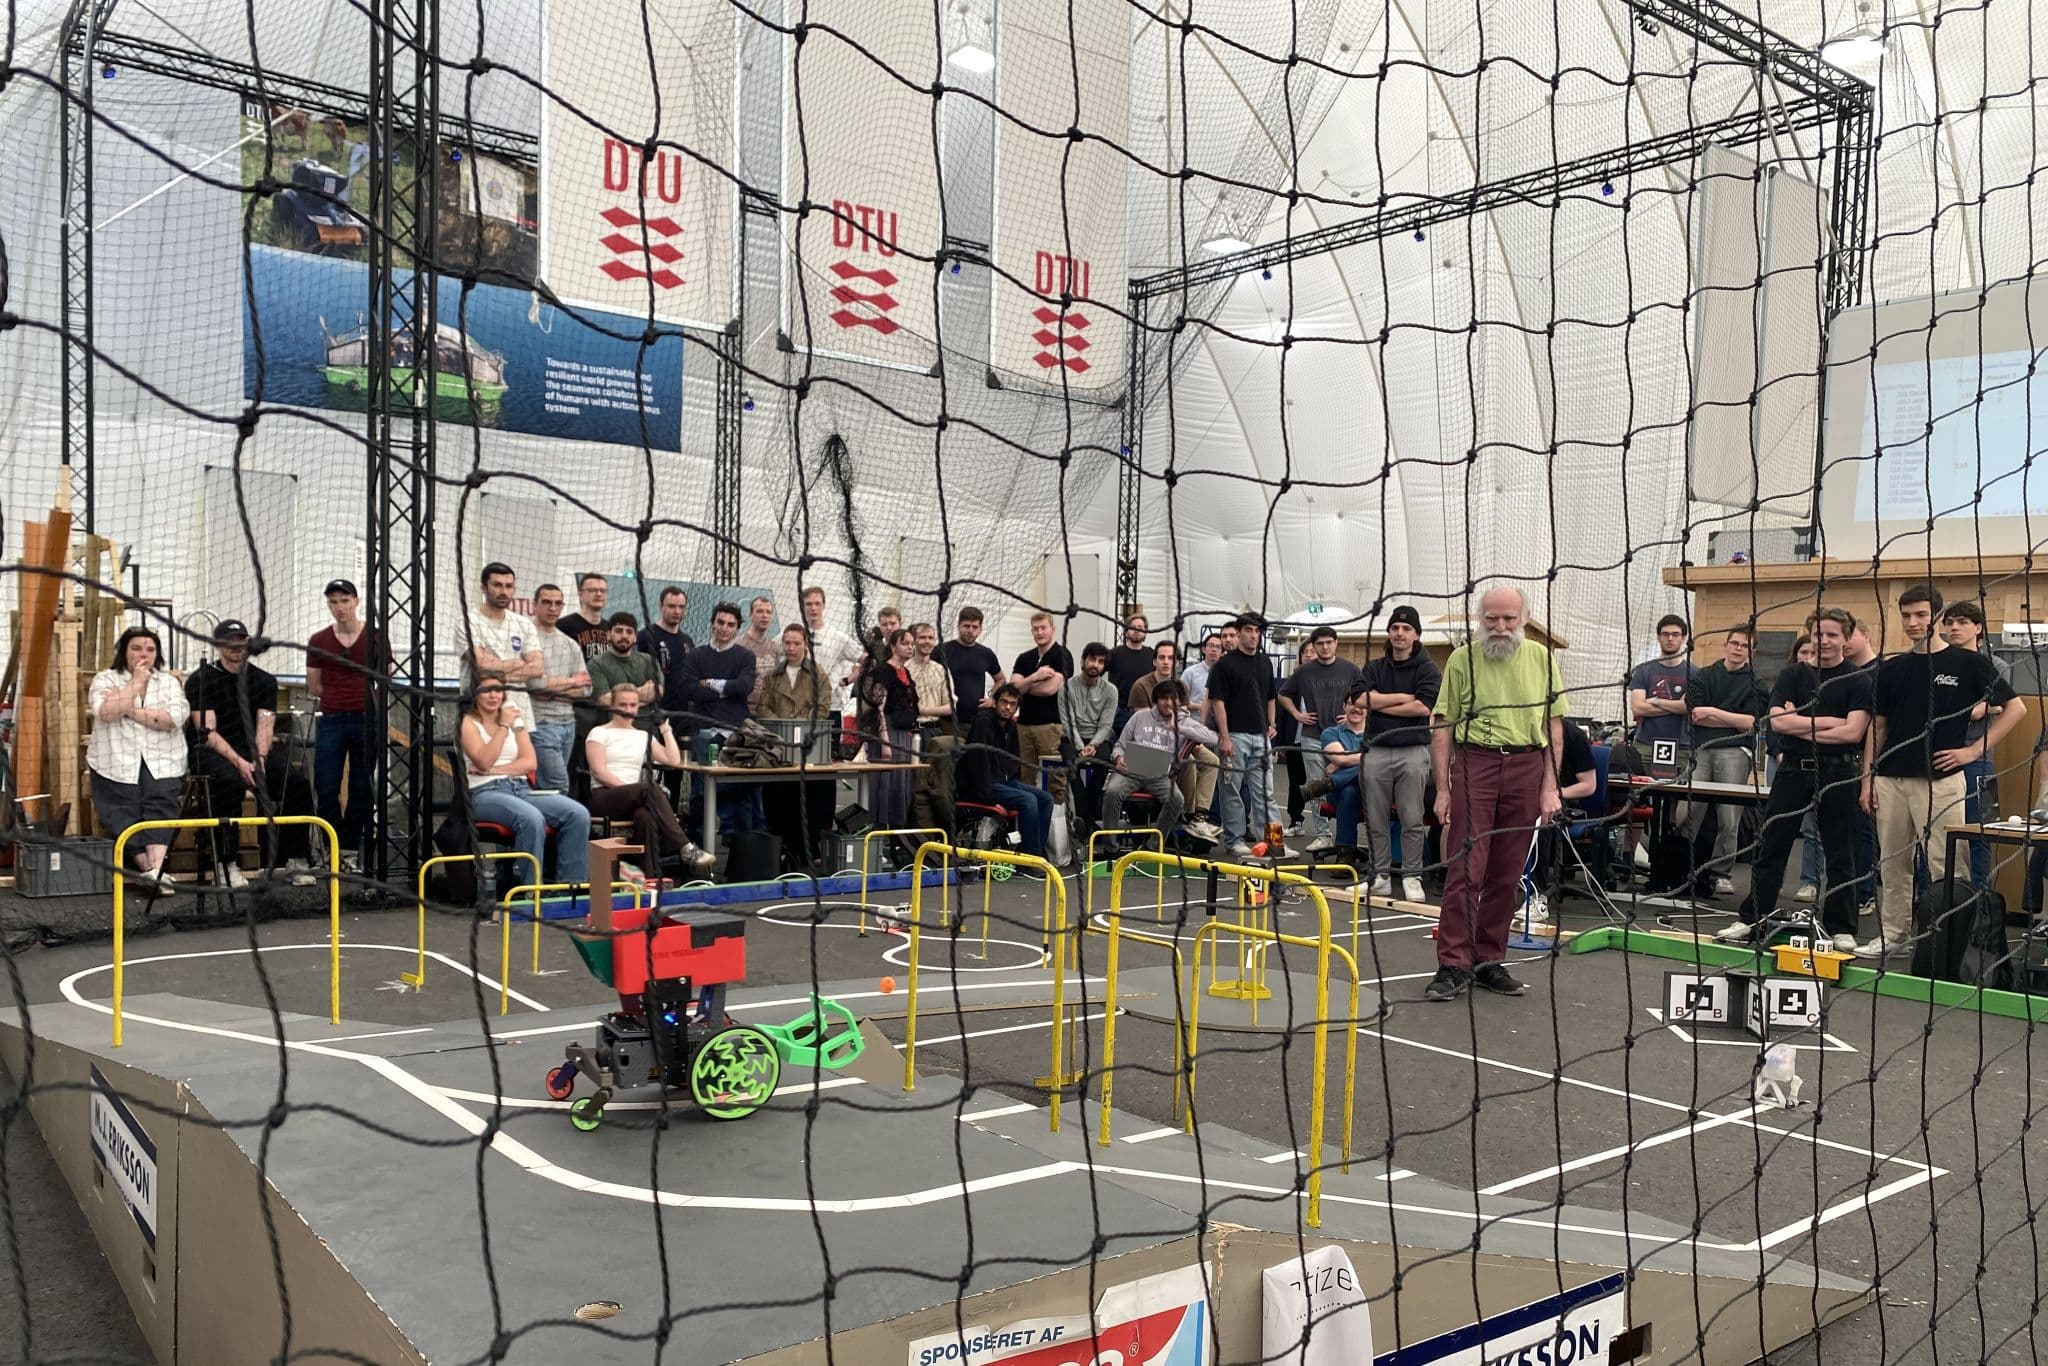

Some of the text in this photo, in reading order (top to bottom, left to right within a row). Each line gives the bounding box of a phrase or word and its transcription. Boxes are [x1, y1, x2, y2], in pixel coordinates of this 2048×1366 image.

[833, 199, 896, 257] DTU
[1036, 250, 1089, 301] DTU
[546, 357, 580, 370] Towards
[582, 364, 587, 372] a
[545, 380, 560, 389] the
[561, 383, 600, 395] seamless
[546, 370, 580, 382] resilient
[581, 375, 605, 385] world
[606, 378, 641, 390] powere
[545, 391, 555, 400] of
[556, 392, 589, 405] humans
[591, 399, 610, 407] with
[544, 403, 580, 415] systems
[1675, 1006, 1722, 1018] B B
[1769, 1011, 1778, 1021] C
[108, 1120, 150, 1205] ERIKSSON
[920, 1330, 1035, 1366] SPONSERET
[1040, 1326, 1065, 1343] AF
